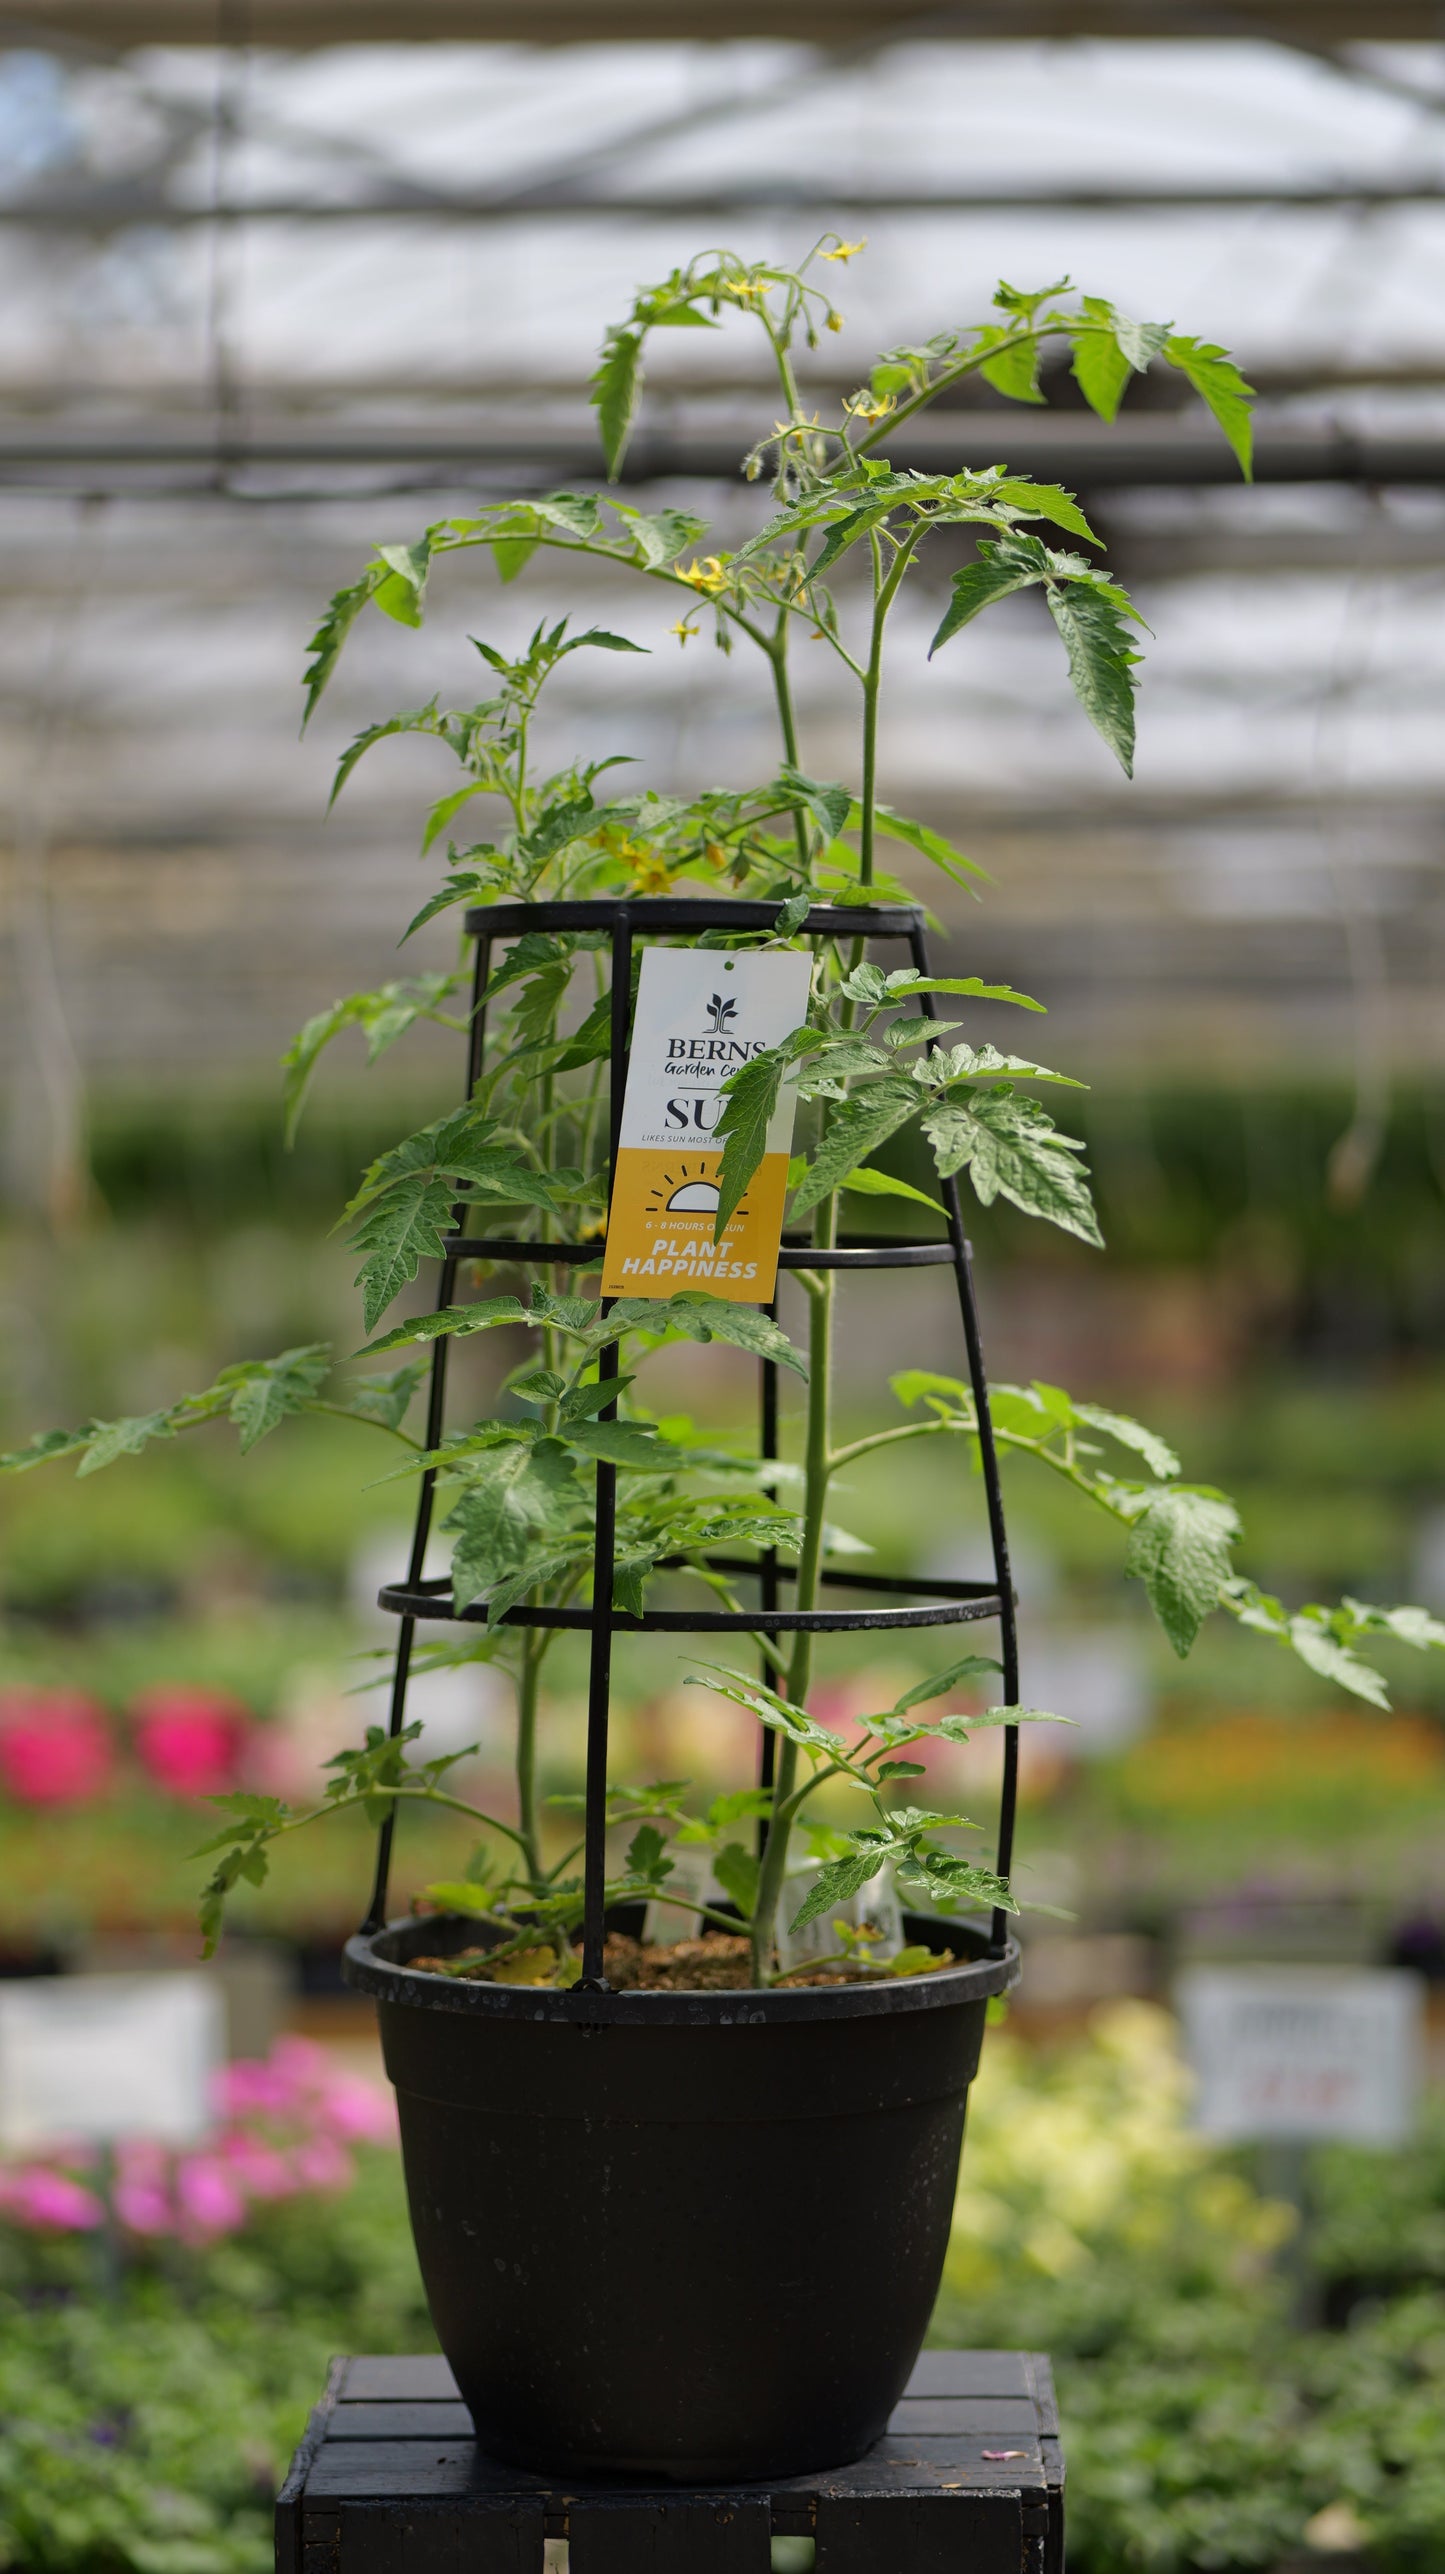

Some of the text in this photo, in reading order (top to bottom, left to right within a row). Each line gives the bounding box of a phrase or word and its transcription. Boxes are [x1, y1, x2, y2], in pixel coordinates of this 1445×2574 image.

[666, 1038, 766, 1061] BERNS
[665, 1061, 715, 1078] Garden
[664, 1098, 729, 1130] SU
[641, 1134, 665, 1142] LIKES
[667, 1135, 686, 1143] SUN
[688, 1136, 712, 1144] MOST
[645, 1221, 653, 1230] 6
[660, 1222, 667, 1230] 8
[669, 1222, 704, 1231] HOURS
[723, 1223, 745, 1232] SUN
[651, 1239, 733, 1258] PLANT
[621, 1258, 758, 1279] HAPPINESS
